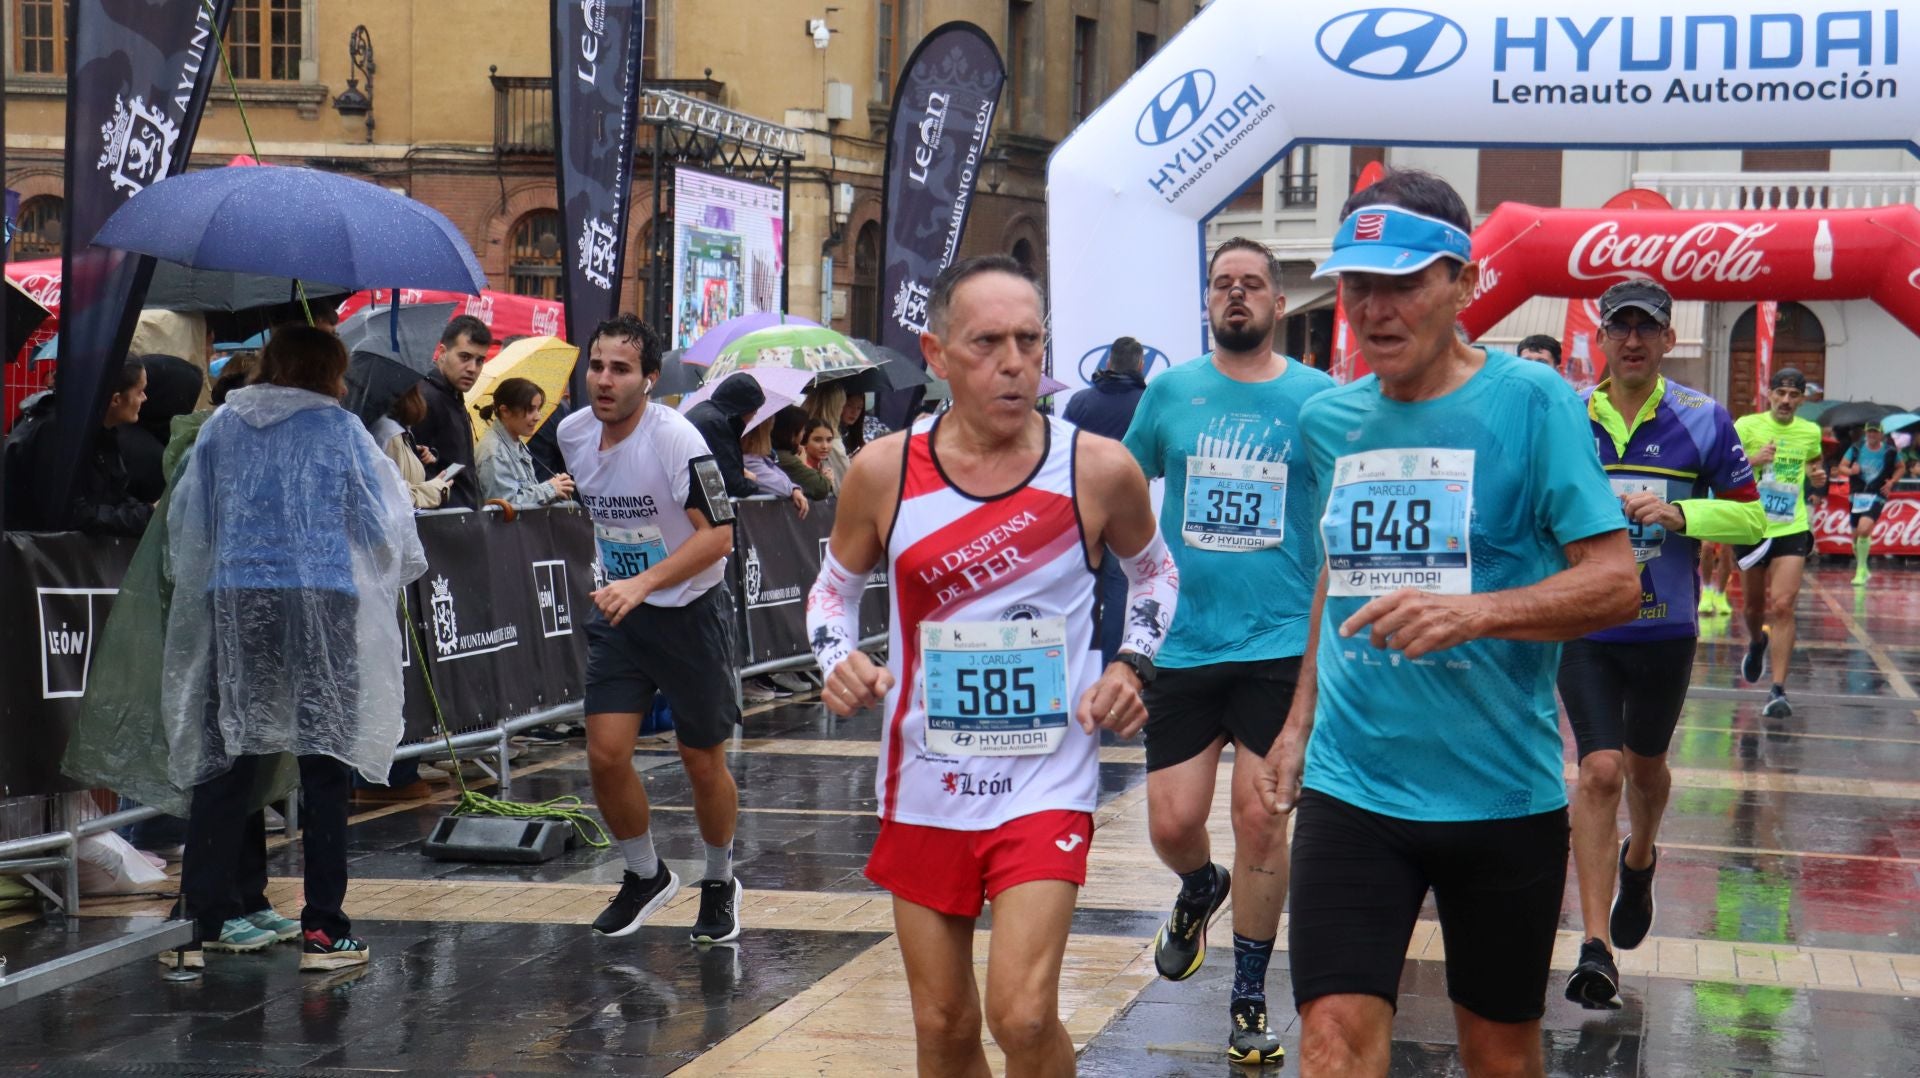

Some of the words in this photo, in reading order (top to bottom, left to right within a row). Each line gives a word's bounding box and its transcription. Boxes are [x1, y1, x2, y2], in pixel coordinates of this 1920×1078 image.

[1493, 9, 1899, 72] HYUNDAI
[1492, 78, 1652, 104] Lemauto
[1662, 71, 1898, 104] Automoción
[972, 99, 991, 142] LEÓN
[1147, 84, 1266, 195] HYUNDAI
[966, 143, 979, 166] DE
[1166, 162, 1212, 204] Lemauto
[1213, 103, 1276, 162] Automoción
[937, 169, 973, 277] UNTAMIENTO
[1567, 220, 1778, 283] Coca-Cola
[1431, 457, 1439, 468] k
[1217, 481, 1231, 489] ALE
[1236, 482, 1255, 490] VEGA
[1368, 485, 1416, 496] MARCELO
[592, 508, 608, 519] THE
[612, 506, 659, 520] BRUNCH
[599, 495, 655, 509] RUNNING
[1207, 489, 1262, 526] 353
[1765, 494, 1789, 514] 375
[1351, 499, 1431, 552] 648
[920, 566, 943, 584] LA
[941, 511, 1038, 572] DESPENSA
[1218, 536, 1265, 547] HYUNDAI
[611, 551, 650, 577] 367
[936, 583, 964, 605] DE
[960, 546, 1032, 592] FER
[1370, 572, 1441, 584] HYUNDAI
[538, 585, 552, 608] LEÓN
[557, 604, 565, 613] ES
[1638, 604, 1667, 619] rail
[48, 622, 85, 655] LEÓN
[954, 630, 962, 641] k
[1031, 627, 1039, 638] k
[957, 667, 1036, 715] 585
[979, 732, 1047, 746] HYUNDAI
[959, 772, 1013, 797] León
